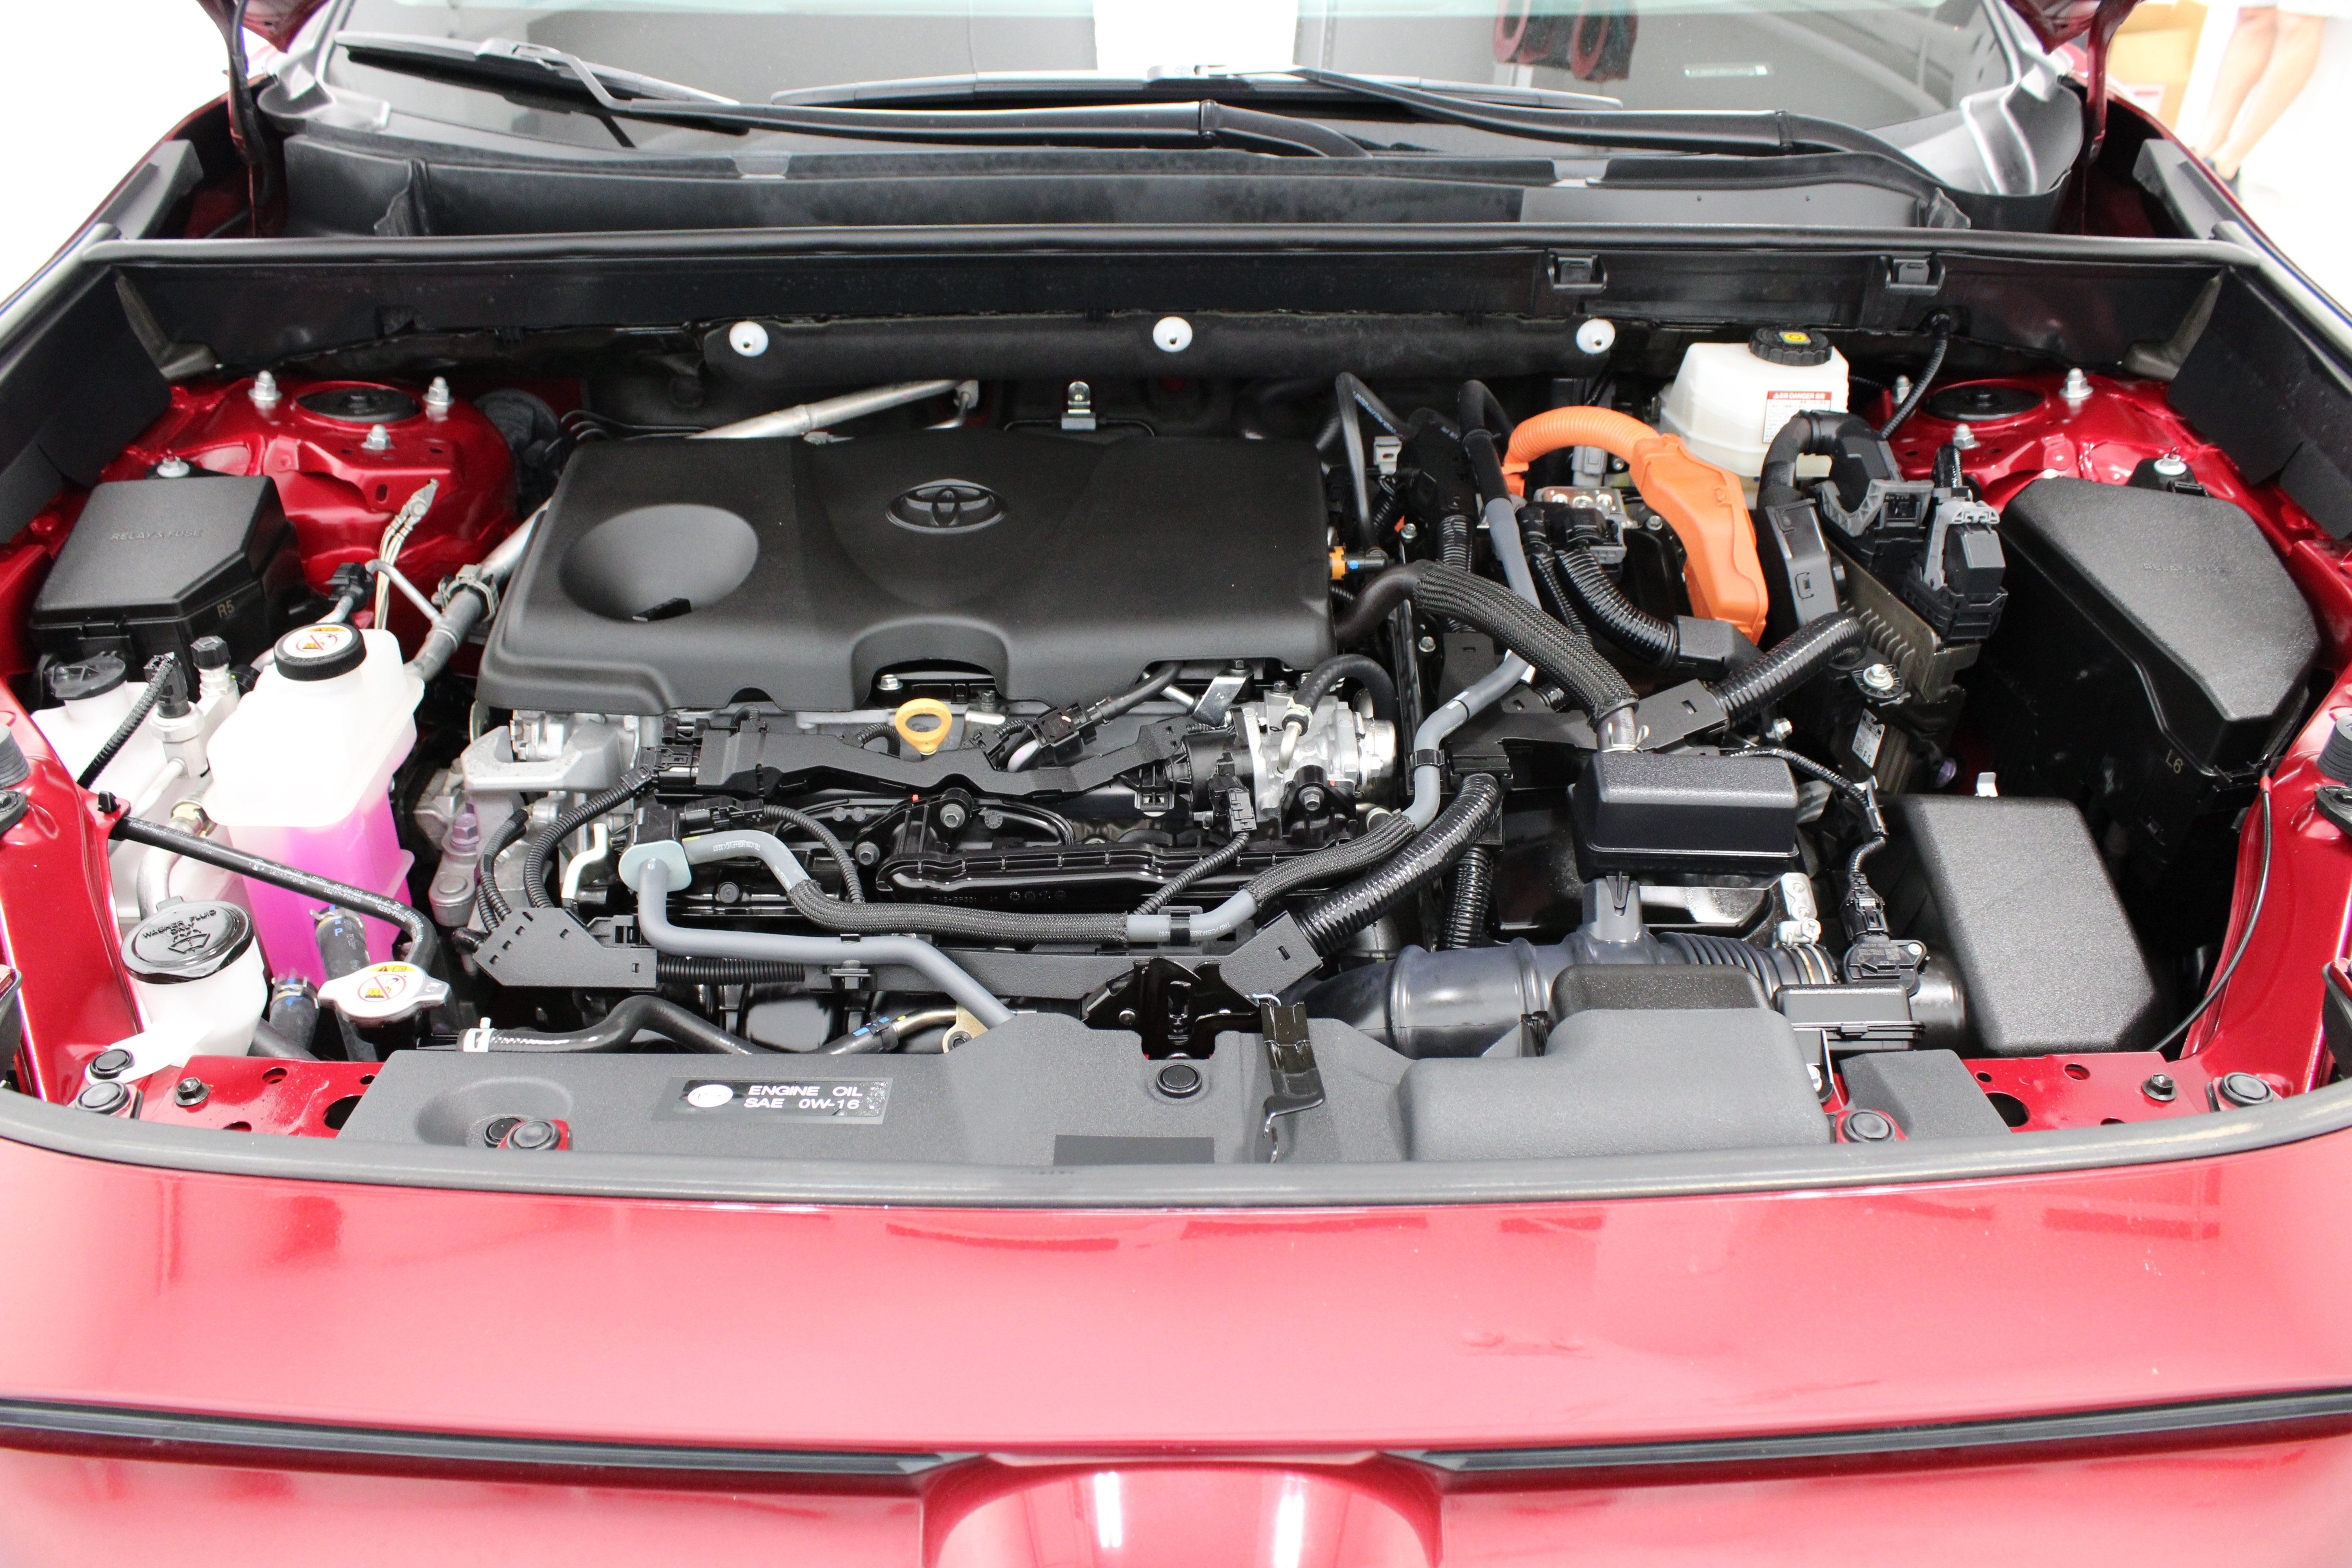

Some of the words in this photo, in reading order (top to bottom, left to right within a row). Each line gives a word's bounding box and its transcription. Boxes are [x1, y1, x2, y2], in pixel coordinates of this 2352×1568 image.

[217, 599, 234, 617] R5
[2166, 748, 2183, 773] L6
[143, 921, 184, 939] WASHER
[189, 909, 216, 923] FLUID
[170, 922, 195, 935] ONLY
[1220, 922, 1231, 931] TRD
[748, 1085, 820, 1096] ENGINE
[832, 1086, 864, 1097] OIL
[744, 1098, 785, 1109] SAE
[798, 1098, 860, 1110] 0W-16
